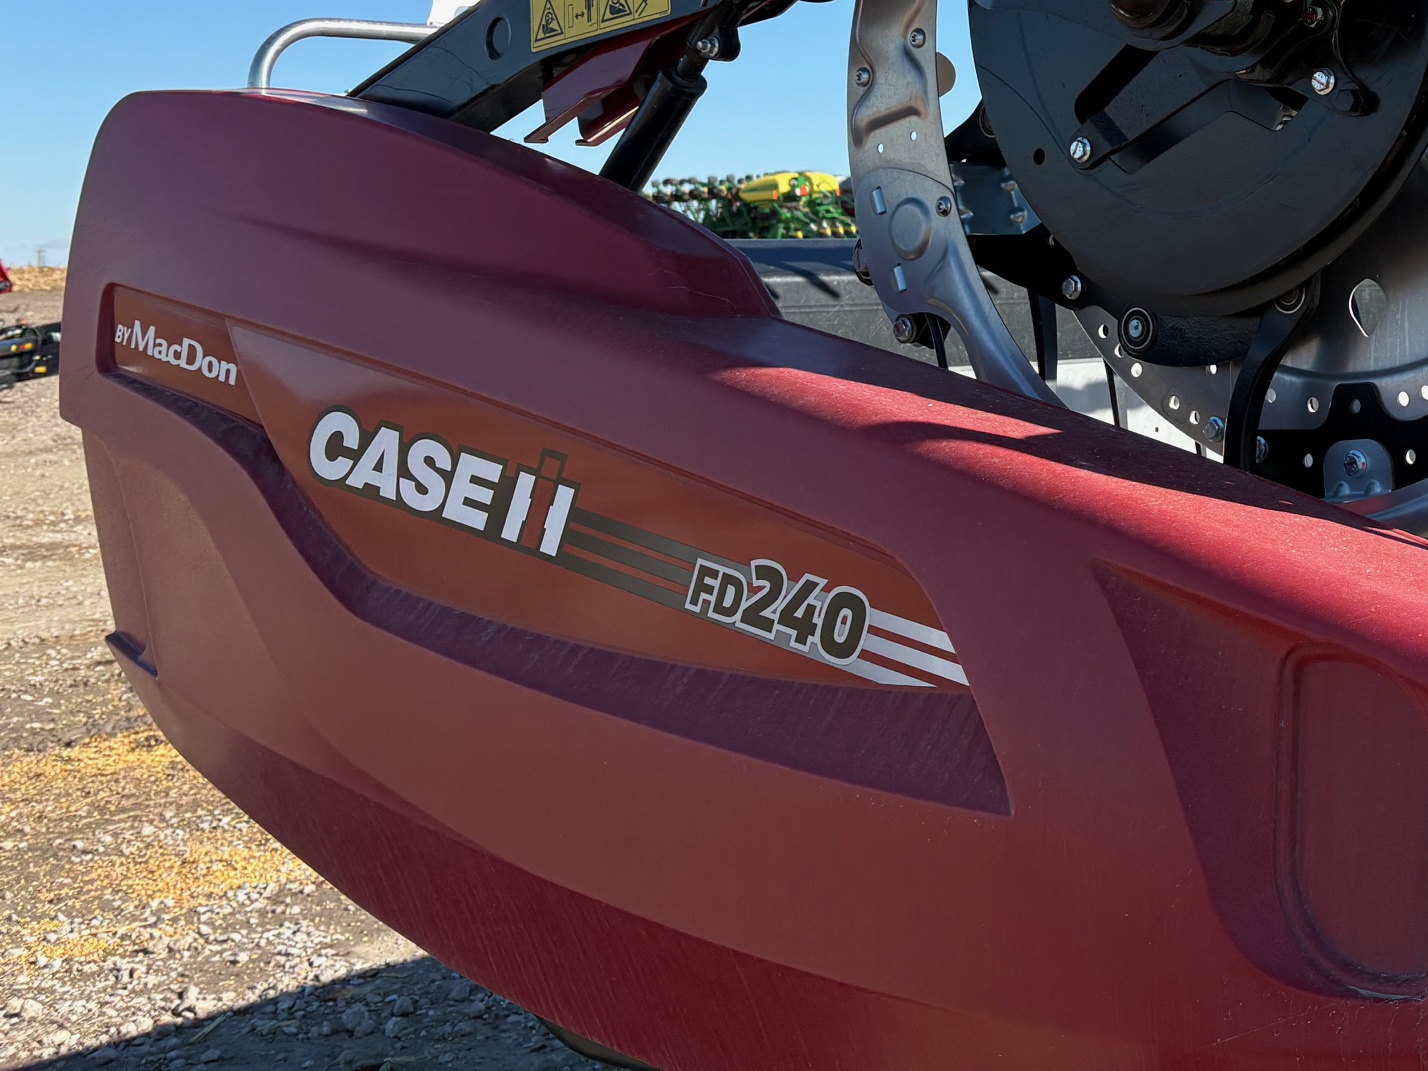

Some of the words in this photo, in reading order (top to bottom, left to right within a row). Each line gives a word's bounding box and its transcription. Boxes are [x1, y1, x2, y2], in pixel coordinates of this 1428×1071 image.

[114, 324, 131, 346] BY
[131, 320, 238, 386] MacDon
[310, 411, 503, 531] CASE
[685, 558, 871, 666] FD240
